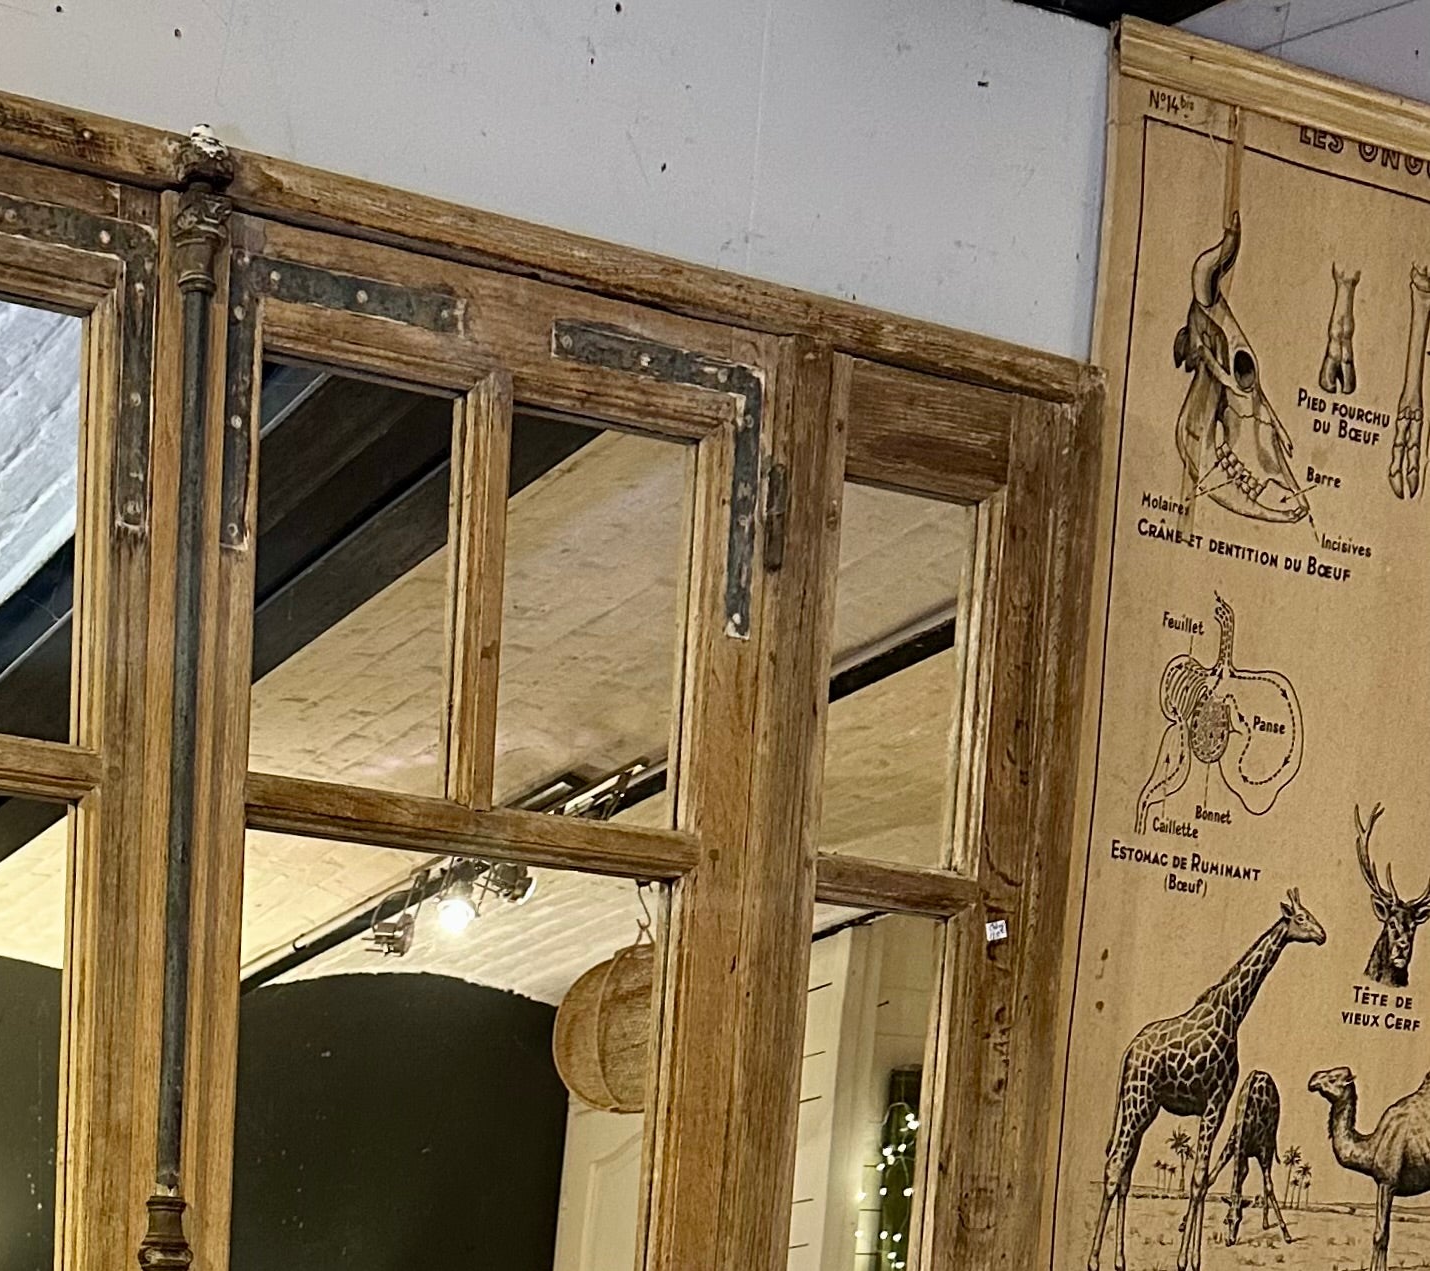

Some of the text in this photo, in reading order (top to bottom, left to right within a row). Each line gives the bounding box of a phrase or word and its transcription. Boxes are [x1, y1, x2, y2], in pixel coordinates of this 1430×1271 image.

[1358, 141, 1430, 181] ONG
[1297, 387, 1391, 428] PIED FOURCHU
[1313, 418, 1331, 435] DU
[1306, 466, 1341, 489] Barre
[1188, 534, 1204, 550] ET
[1209, 538, 1279, 569] DENTITION
[1284, 556, 1302, 573] DU
[1321, 532, 1372, 558] Incisives
[1162, 610, 1205, 636] Feuillet
[1253, 715, 1286, 735] Panse
[1195, 805, 1232, 825] Bonnet
[1152, 816, 1199, 839] Caillette
[1111, 839, 1262, 882] ESTOMAC DE RUMINANT
[1395, 996, 1413, 1010] DE
[1341, 1011, 1421, 1032] VIEUX CERF
